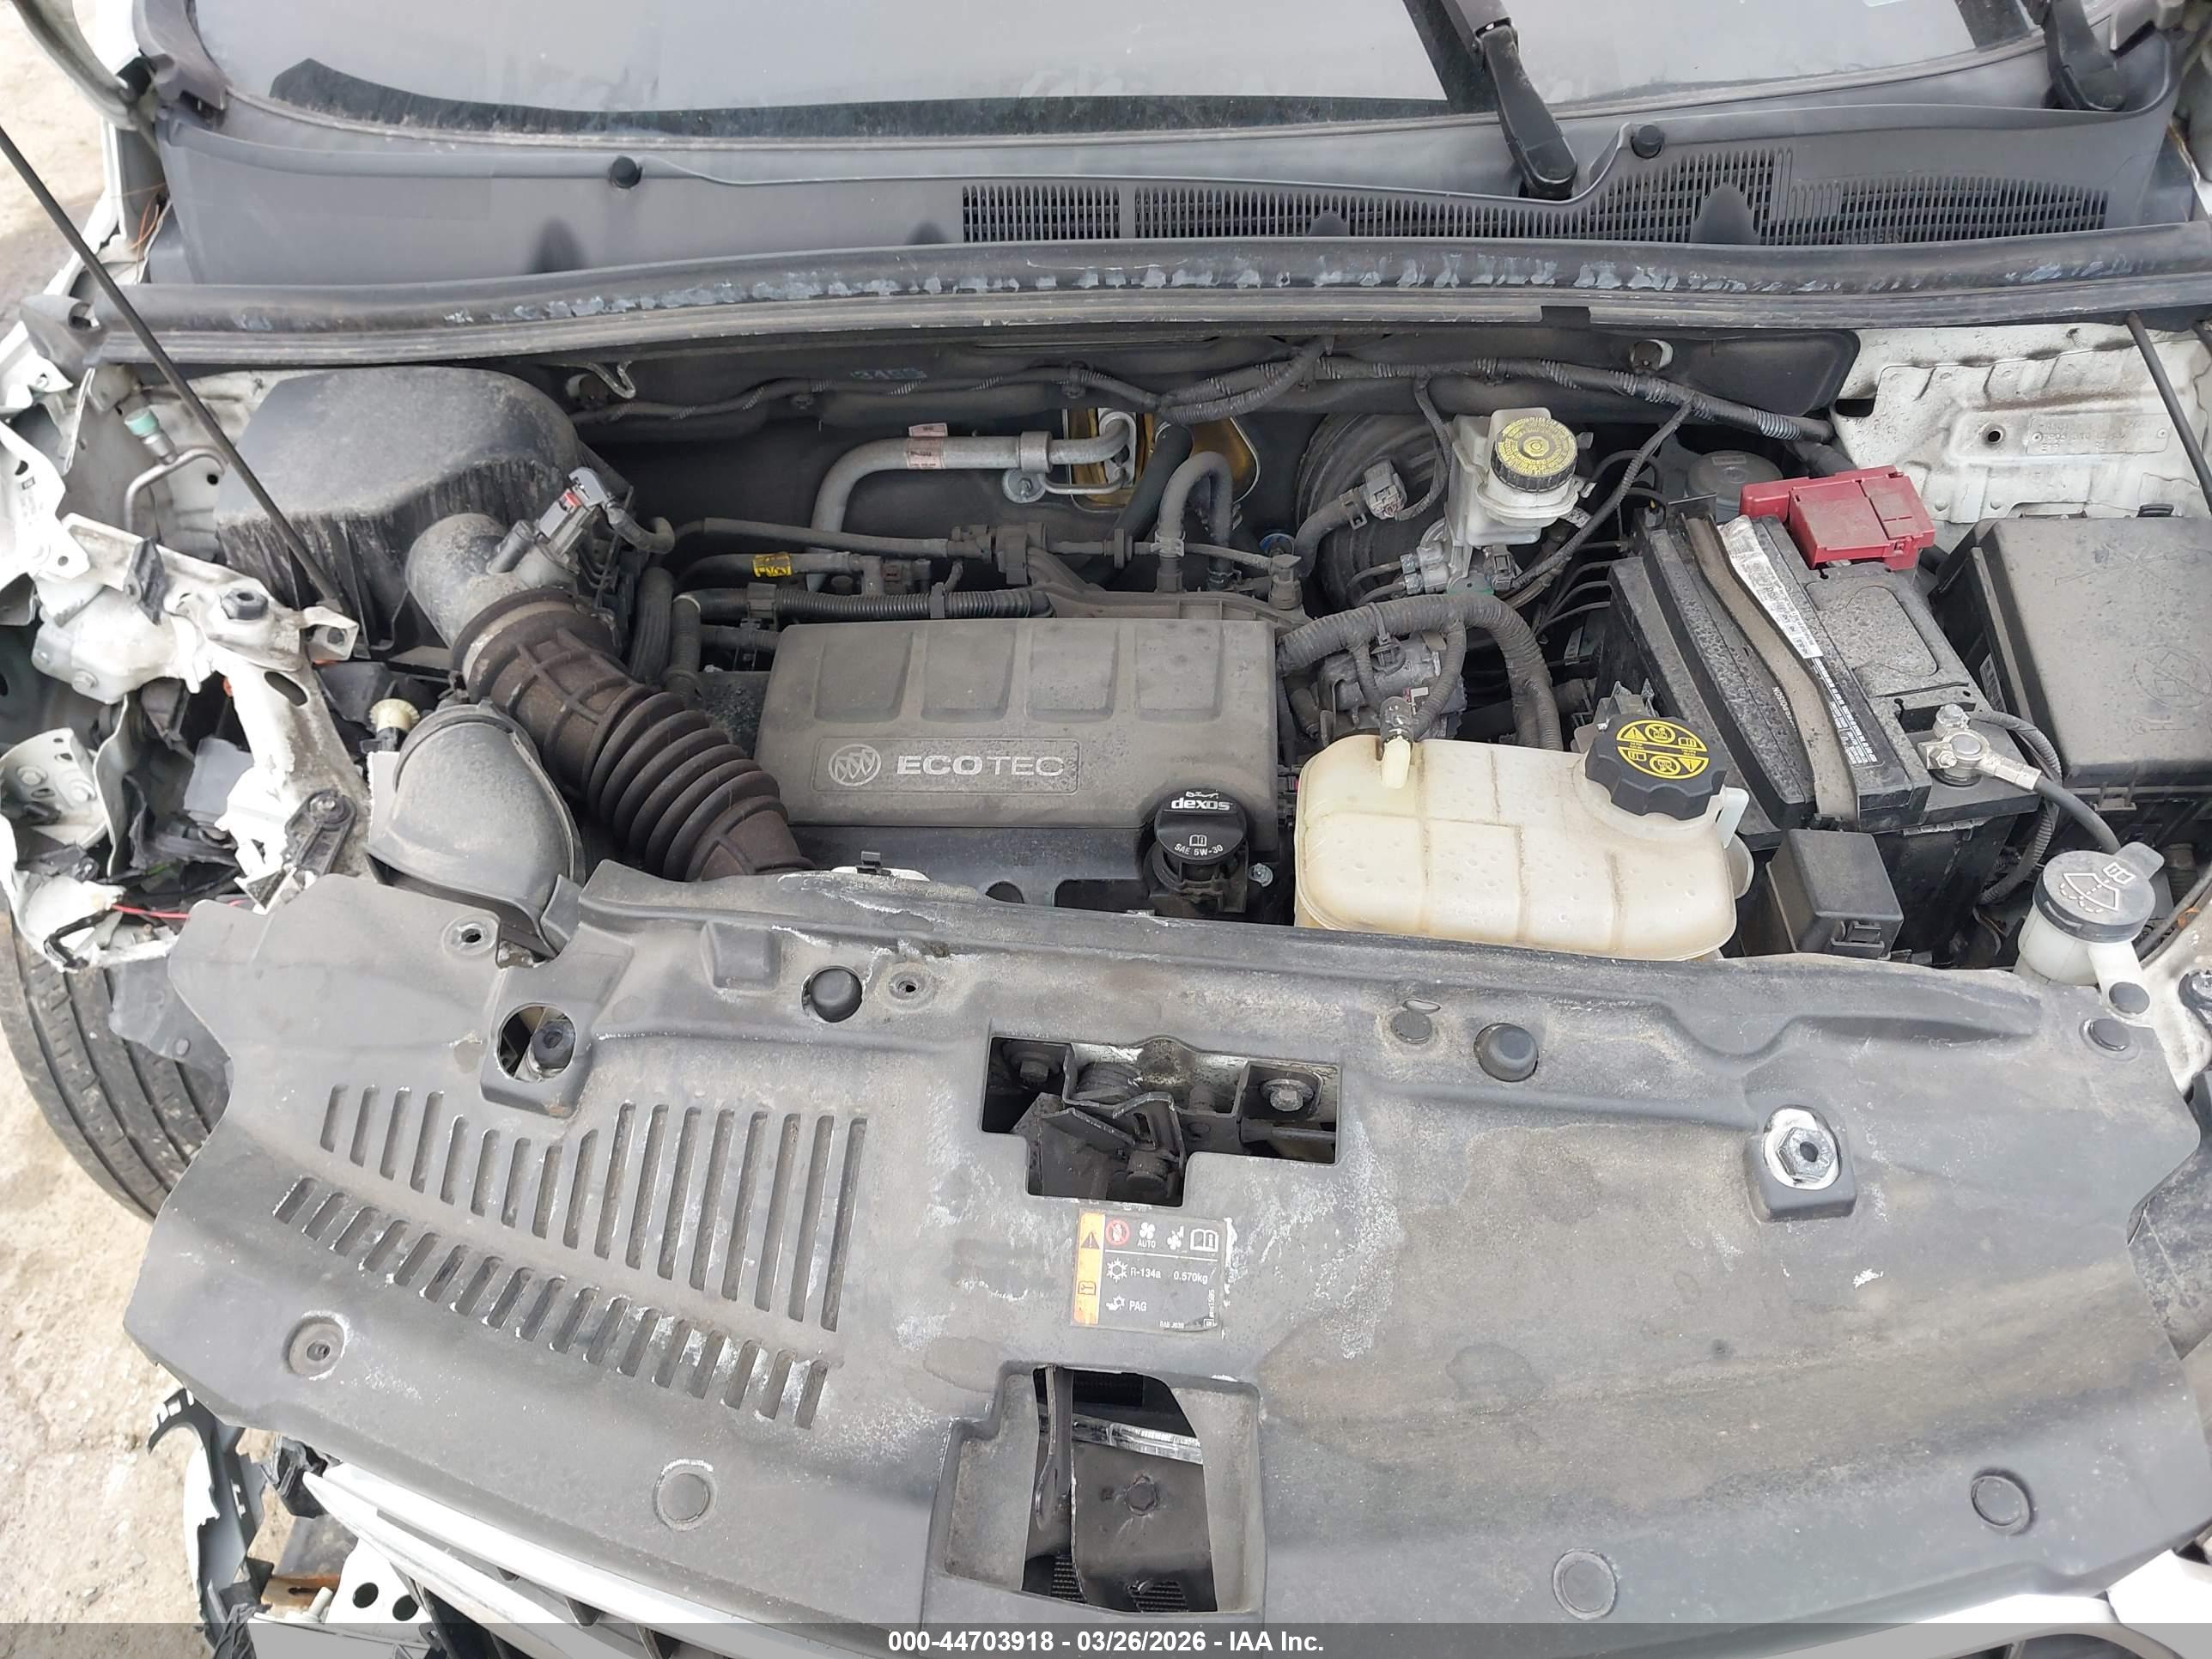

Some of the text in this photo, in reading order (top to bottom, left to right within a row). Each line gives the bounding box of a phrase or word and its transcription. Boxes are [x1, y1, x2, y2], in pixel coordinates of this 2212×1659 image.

[897, 755, 1065, 776] ECOTEC
[1170, 797, 1231, 811] dexos
[1174, 843, 1224, 856] SAE 5W-30
[1137, 1239, 1157, 1249] AUTO
[1130, 1267, 1209, 1285] R-134a 0.570kg
[1128, 1300, 1147, 1312] PAG
